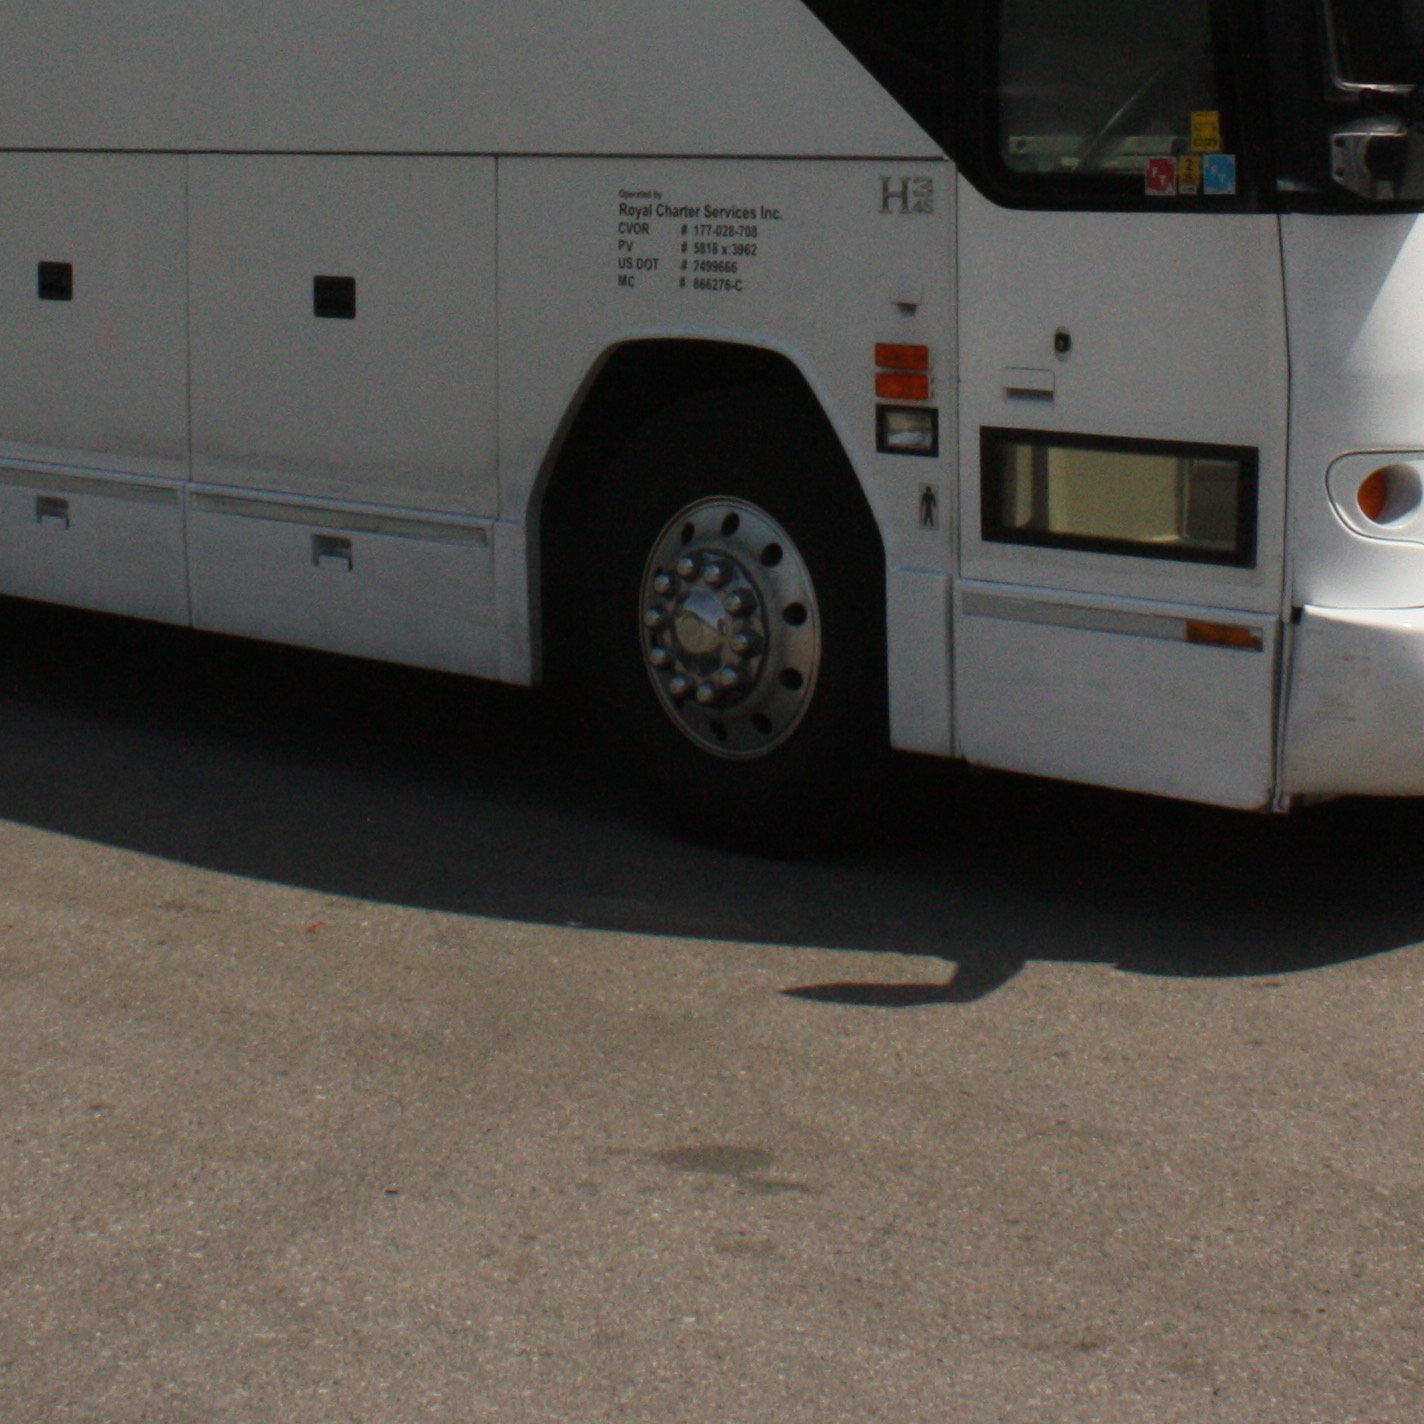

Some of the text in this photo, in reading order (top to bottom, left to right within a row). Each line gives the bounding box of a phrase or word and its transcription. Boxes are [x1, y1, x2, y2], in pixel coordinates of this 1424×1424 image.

[619, 202, 784, 220] Royal Charter Services Inc.
[618, 221, 650, 235] CVOR
[618, 239, 634, 253] PV
[618, 256, 634, 270] US
[636, 257, 659, 271] DOT
[618, 274, 636, 289] MC
